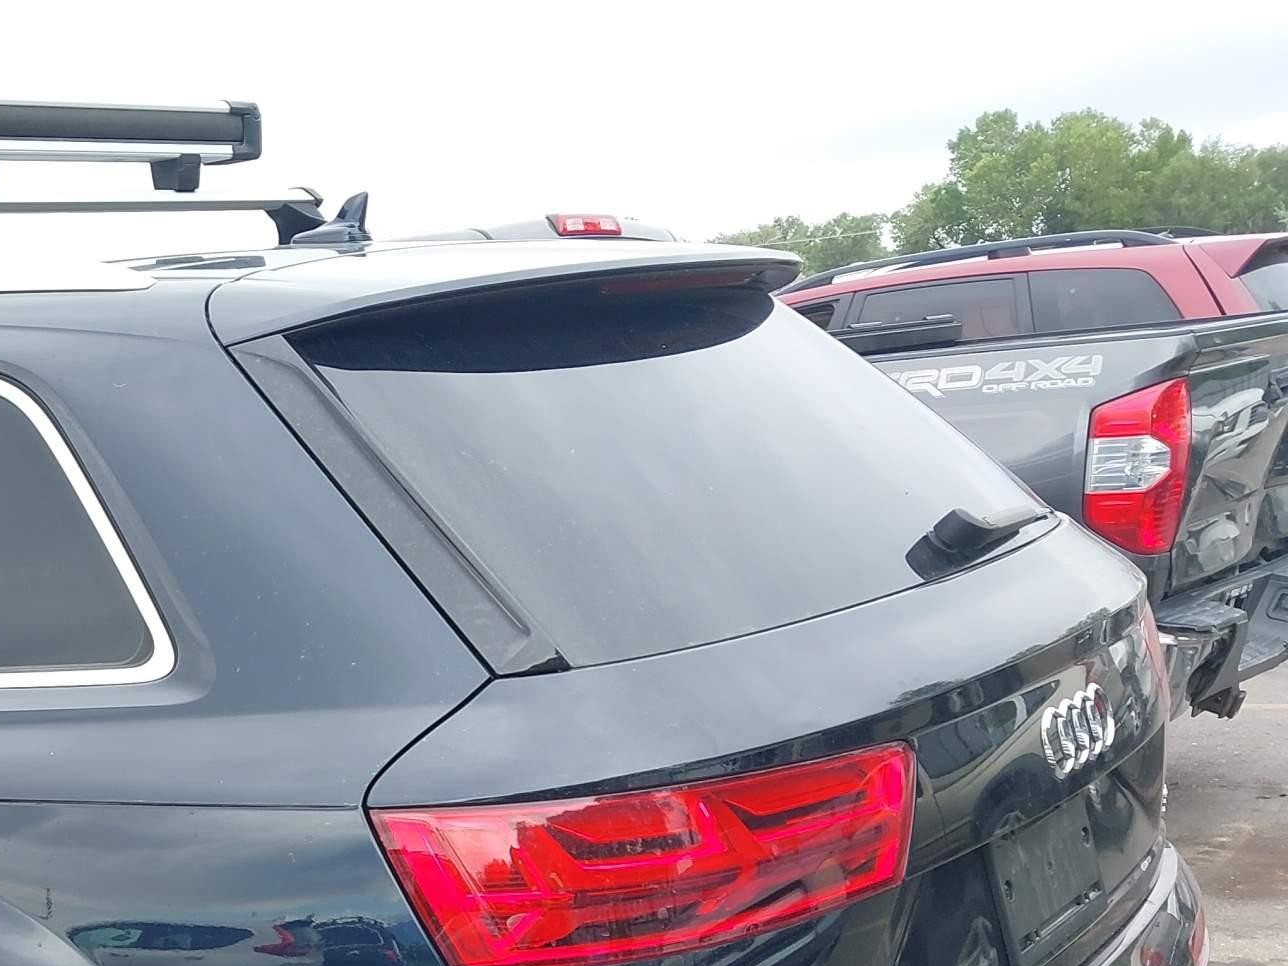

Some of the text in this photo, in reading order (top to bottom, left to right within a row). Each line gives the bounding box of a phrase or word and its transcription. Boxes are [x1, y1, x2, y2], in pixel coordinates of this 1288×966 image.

[983, 354, 1104, 382] 4X4
[982, 376, 1095, 394] OFF ROAD
